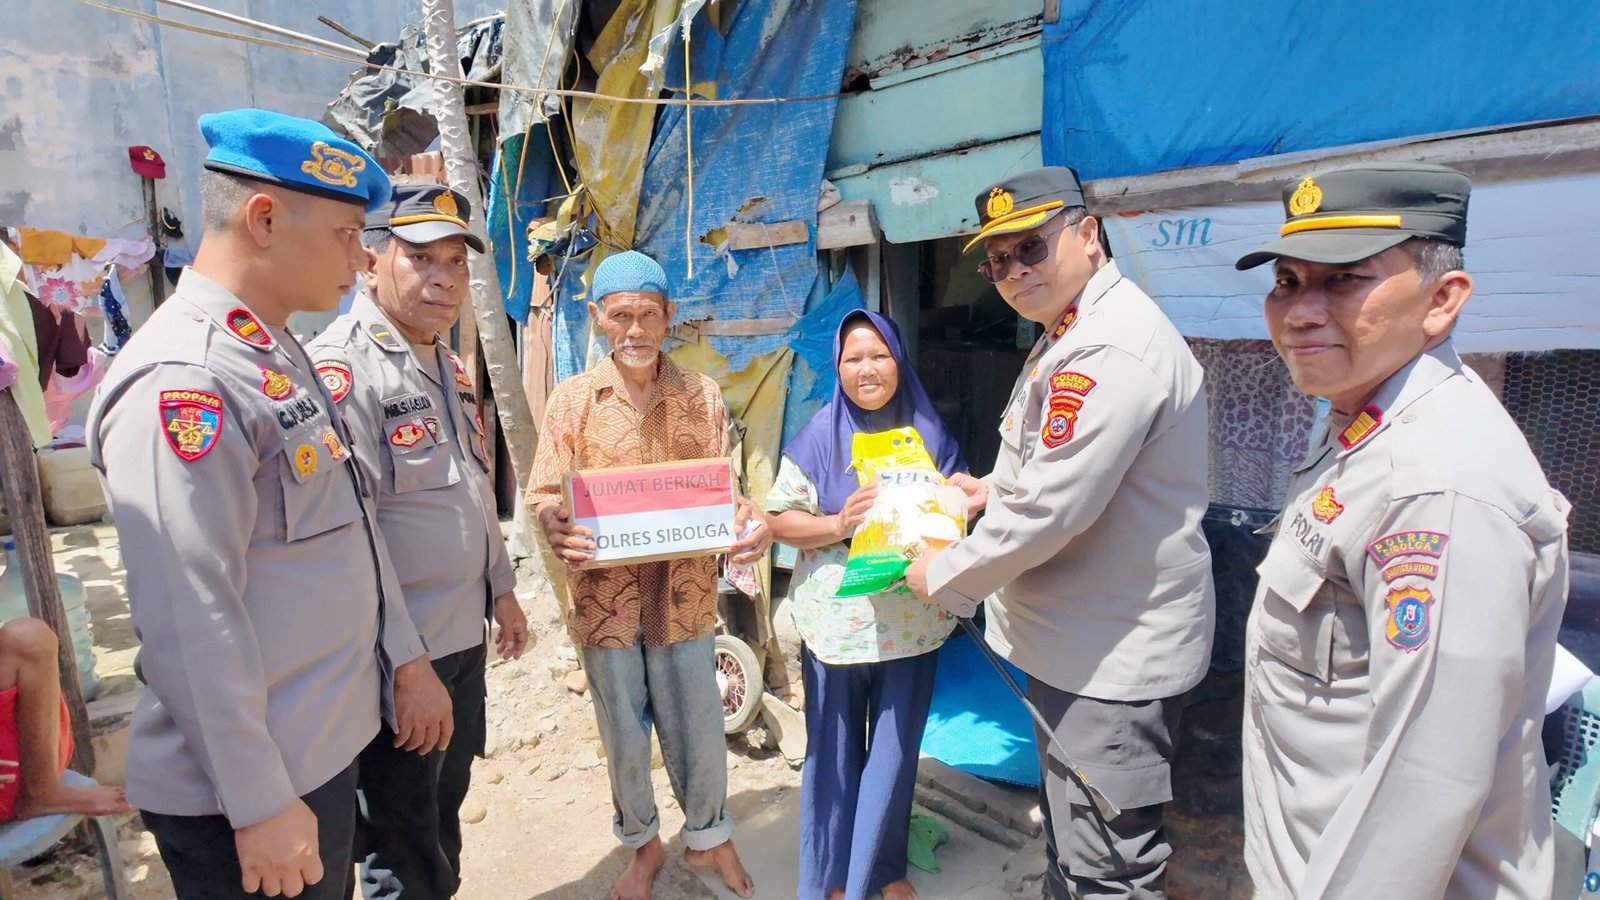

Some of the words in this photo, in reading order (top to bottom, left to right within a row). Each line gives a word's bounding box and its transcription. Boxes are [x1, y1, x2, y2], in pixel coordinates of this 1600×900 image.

[1053, 374, 1089, 387] POLRES
[163, 392, 220, 407] PROPAM
[584, 479, 647, 497] JUMAT
[653, 473, 721, 491] BERKAH
[657, 523, 729, 543] SIBOLGA
[1291, 514, 1325, 557] POLRI
[1375, 534, 1439, 552] POLRES
[1383, 542, 1431, 556] SIBOLGA
